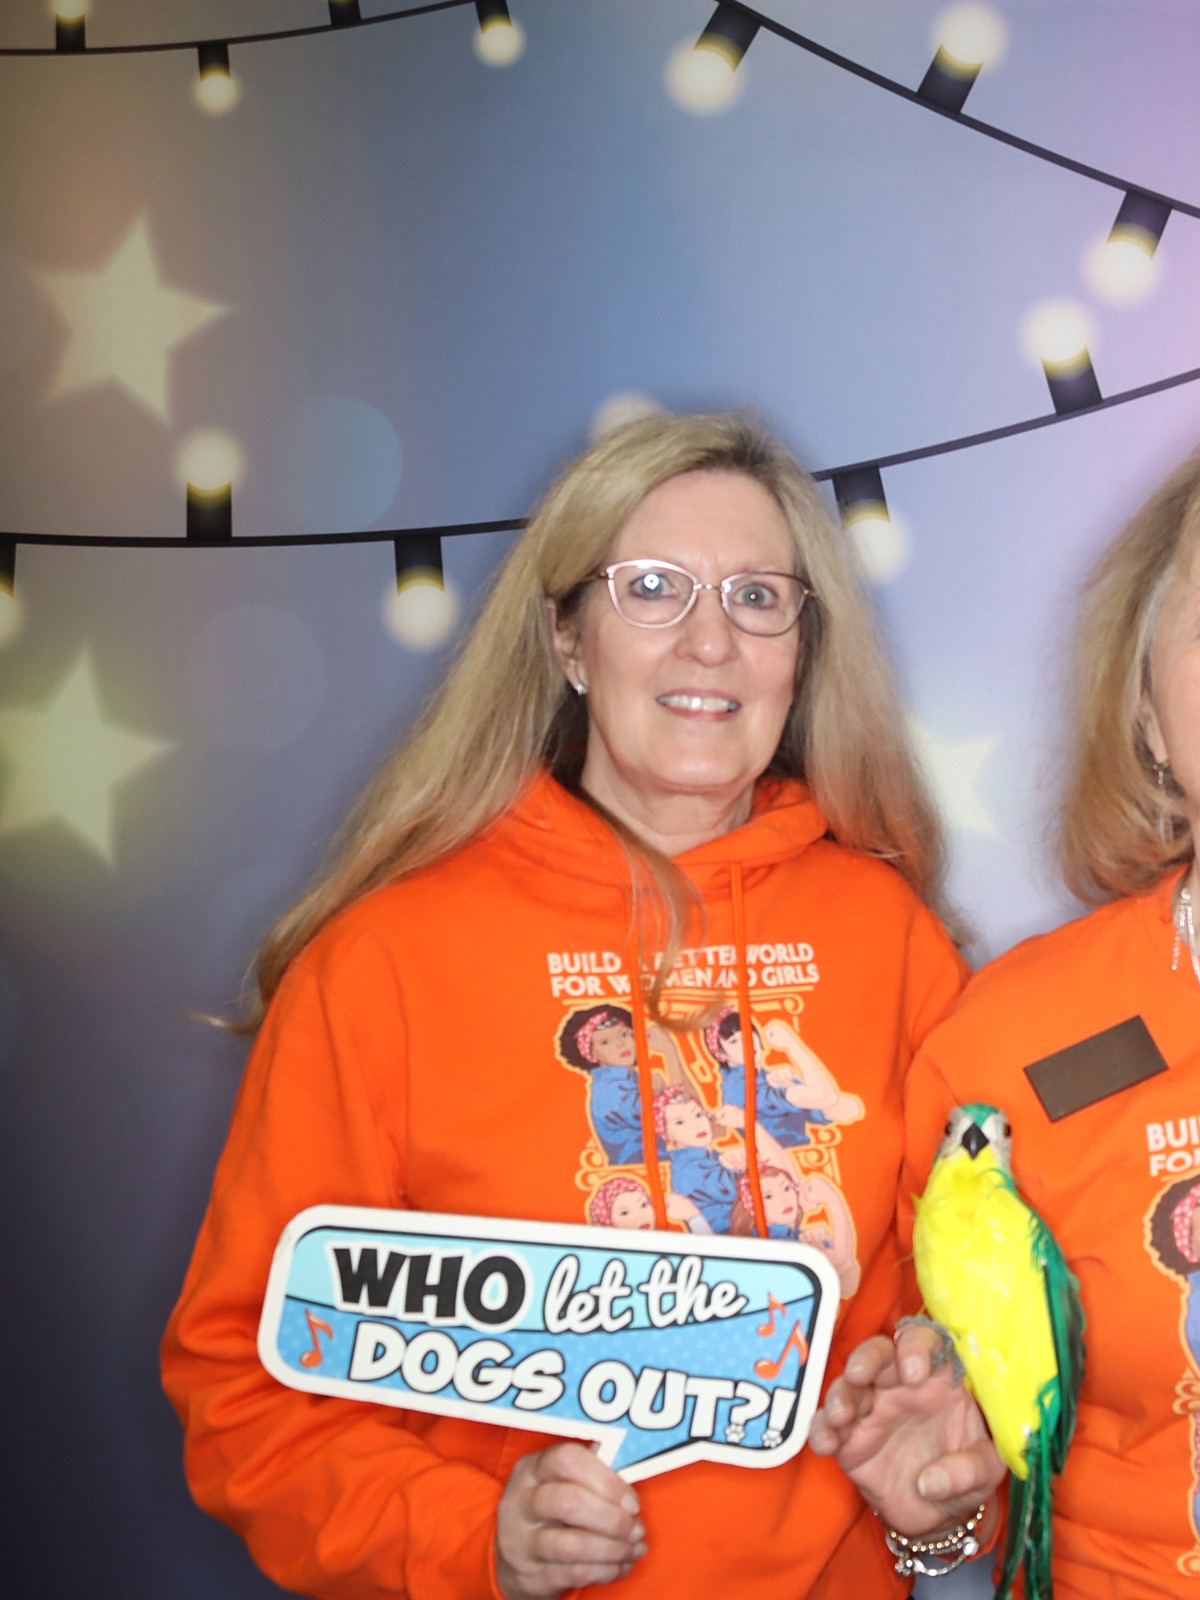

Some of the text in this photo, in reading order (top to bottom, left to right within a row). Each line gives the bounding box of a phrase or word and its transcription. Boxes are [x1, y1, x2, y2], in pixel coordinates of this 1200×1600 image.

[547, 952, 622, 974] BUILD
[551, 975, 606, 997] FOR
[761, 963, 820, 987] GIRLS
[332, 1247, 748, 1332] WHO let the
[349, 1321, 797, 1448] DOGS OUT?!
